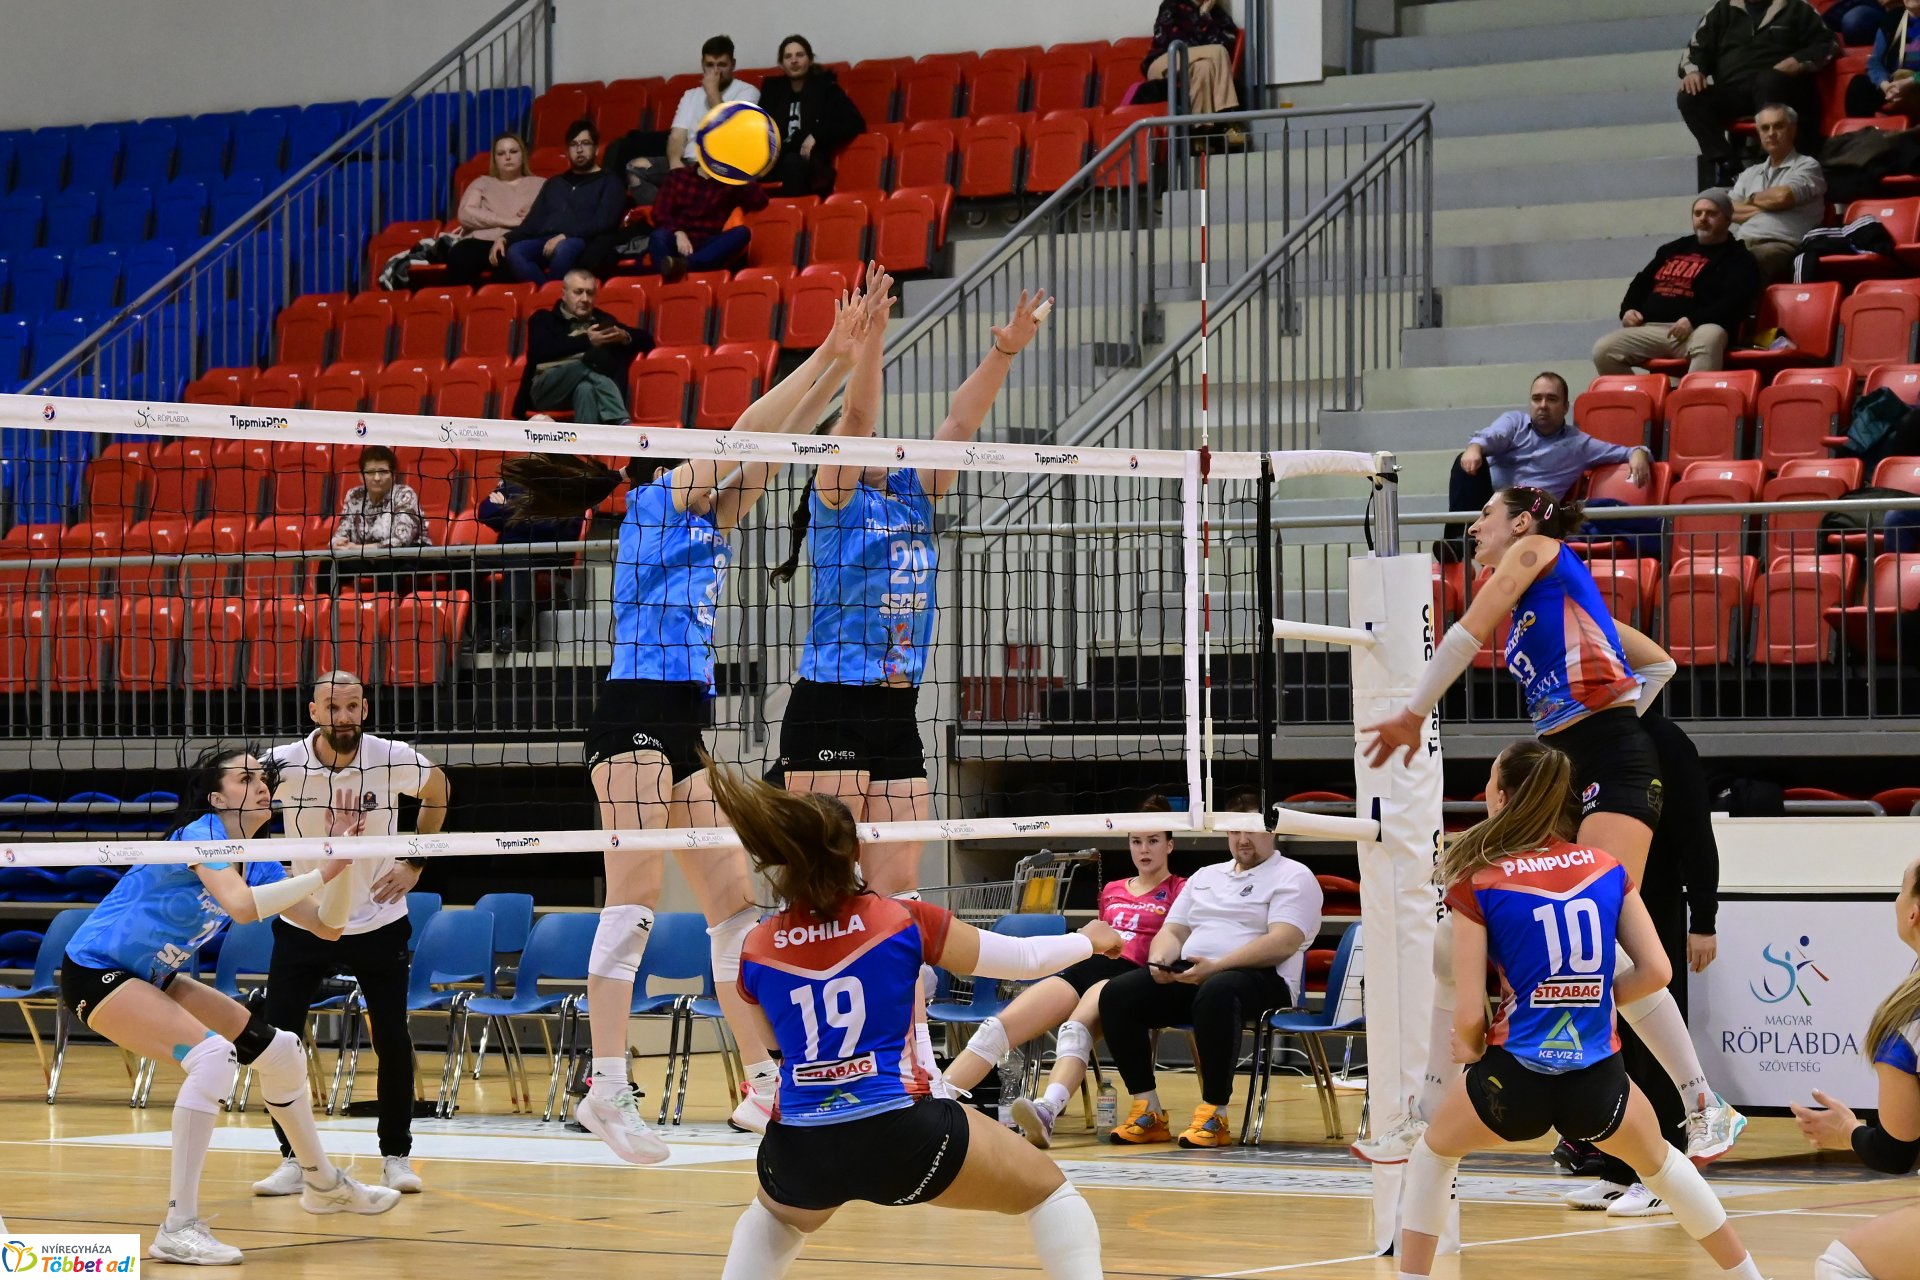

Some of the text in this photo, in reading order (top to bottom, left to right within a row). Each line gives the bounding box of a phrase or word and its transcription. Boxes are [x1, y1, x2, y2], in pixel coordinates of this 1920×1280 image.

[229, 414, 288, 430] TippmixPRO
[524, 429, 578, 443] TippmixPRO
[1034, 452, 1079, 465] TippmixPRO
[890, 540, 928, 585] 20
[1501, 849, 1595, 877] PAMPUCH
[773, 914, 867, 949] SOHILA
[1532, 897, 1603, 976] 10
[1534, 985, 1601, 998] STRABAG
[789, 975, 867, 1062] 19
[1764, 1015, 1813, 1026] MAGYAR
[1722, 1026, 1859, 1055] RÖPLABDA
[1538, 1050, 1583, 1060] KE-VIZ 21
[1759, 1059, 1821, 1073] SZÖVETSÉG
